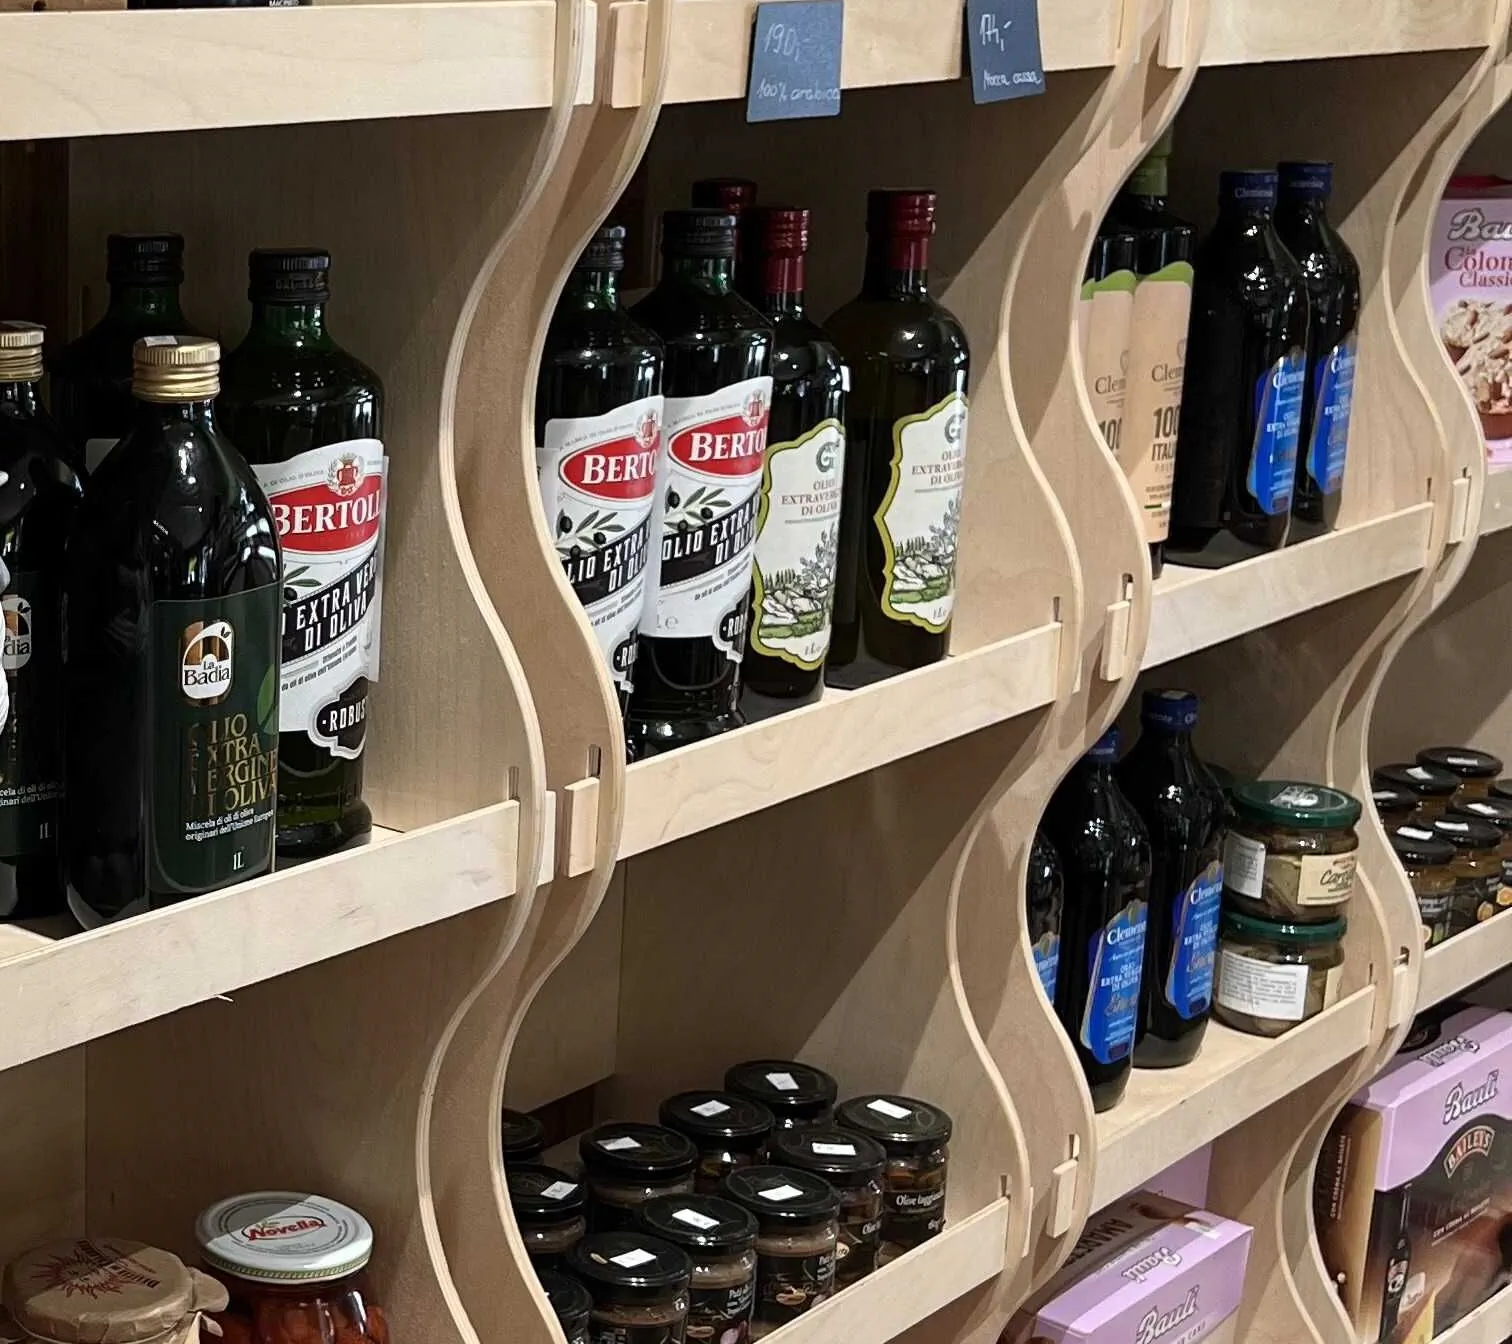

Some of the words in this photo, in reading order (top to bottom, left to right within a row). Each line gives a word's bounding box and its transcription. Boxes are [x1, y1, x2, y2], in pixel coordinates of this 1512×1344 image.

[791, 83, 840, 101] arabica
[662, 528, 703, 560] OLIO
[715, 541, 730, 566] DI
[296, 589, 351, 632] EXTRA
[305, 626, 322, 652] DI
[330, 601, 368, 645] OLIVA
[184, 665, 231, 686] Badia
[203, 662, 216, 670] La
[330, 696, 366, 732] ROBUS
[1443, 1069, 1499, 1125] Bauli
[1448, 1129, 1491, 1170] BAILEYS
[248, 1216, 327, 1241] Novella
